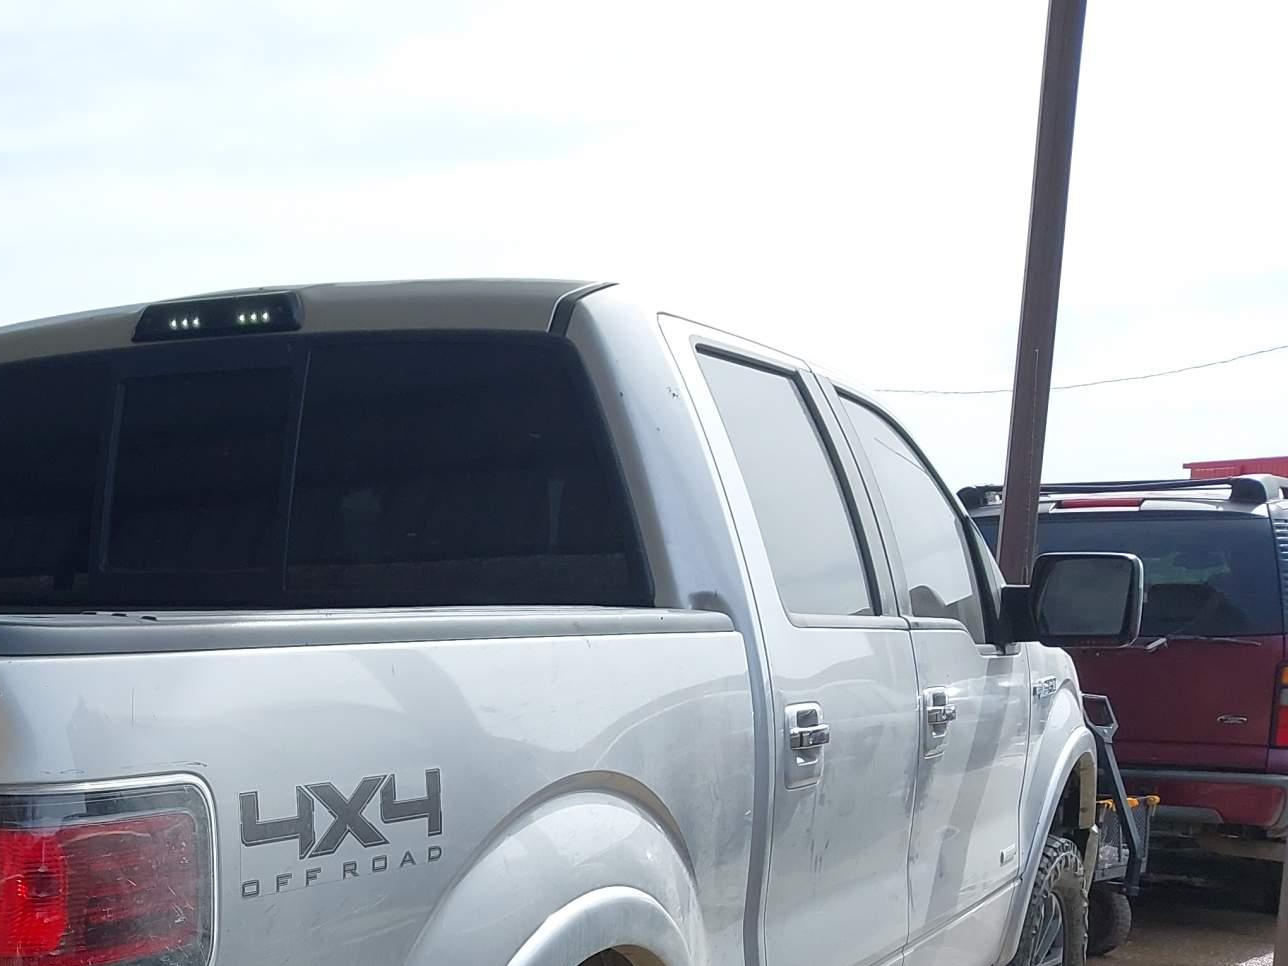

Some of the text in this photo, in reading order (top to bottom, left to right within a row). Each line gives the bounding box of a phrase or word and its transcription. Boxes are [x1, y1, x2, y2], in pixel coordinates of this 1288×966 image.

[239, 768, 443, 860] 4X4
[241, 846, 443, 898] OFF ROAD
